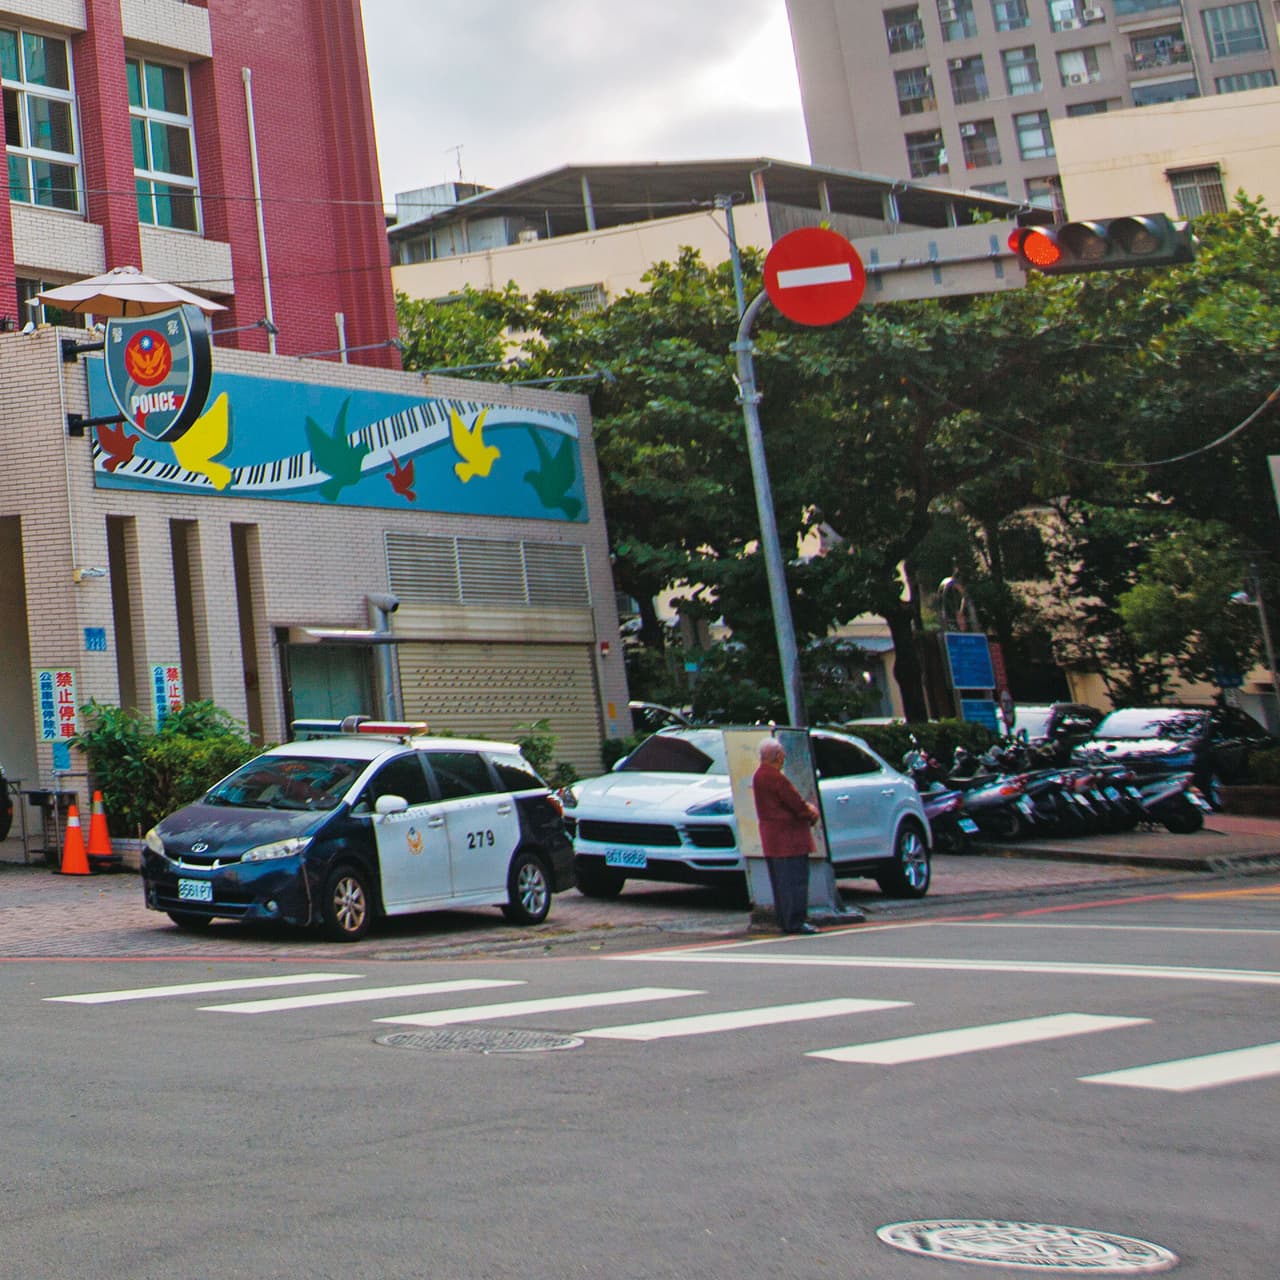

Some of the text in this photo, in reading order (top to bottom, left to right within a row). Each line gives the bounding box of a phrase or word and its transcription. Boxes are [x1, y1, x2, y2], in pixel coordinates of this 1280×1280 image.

[131, 390, 176, 415] POLICE
[56, 671, 77, 739] 禁止停車
[467, 829, 495, 849] 279
